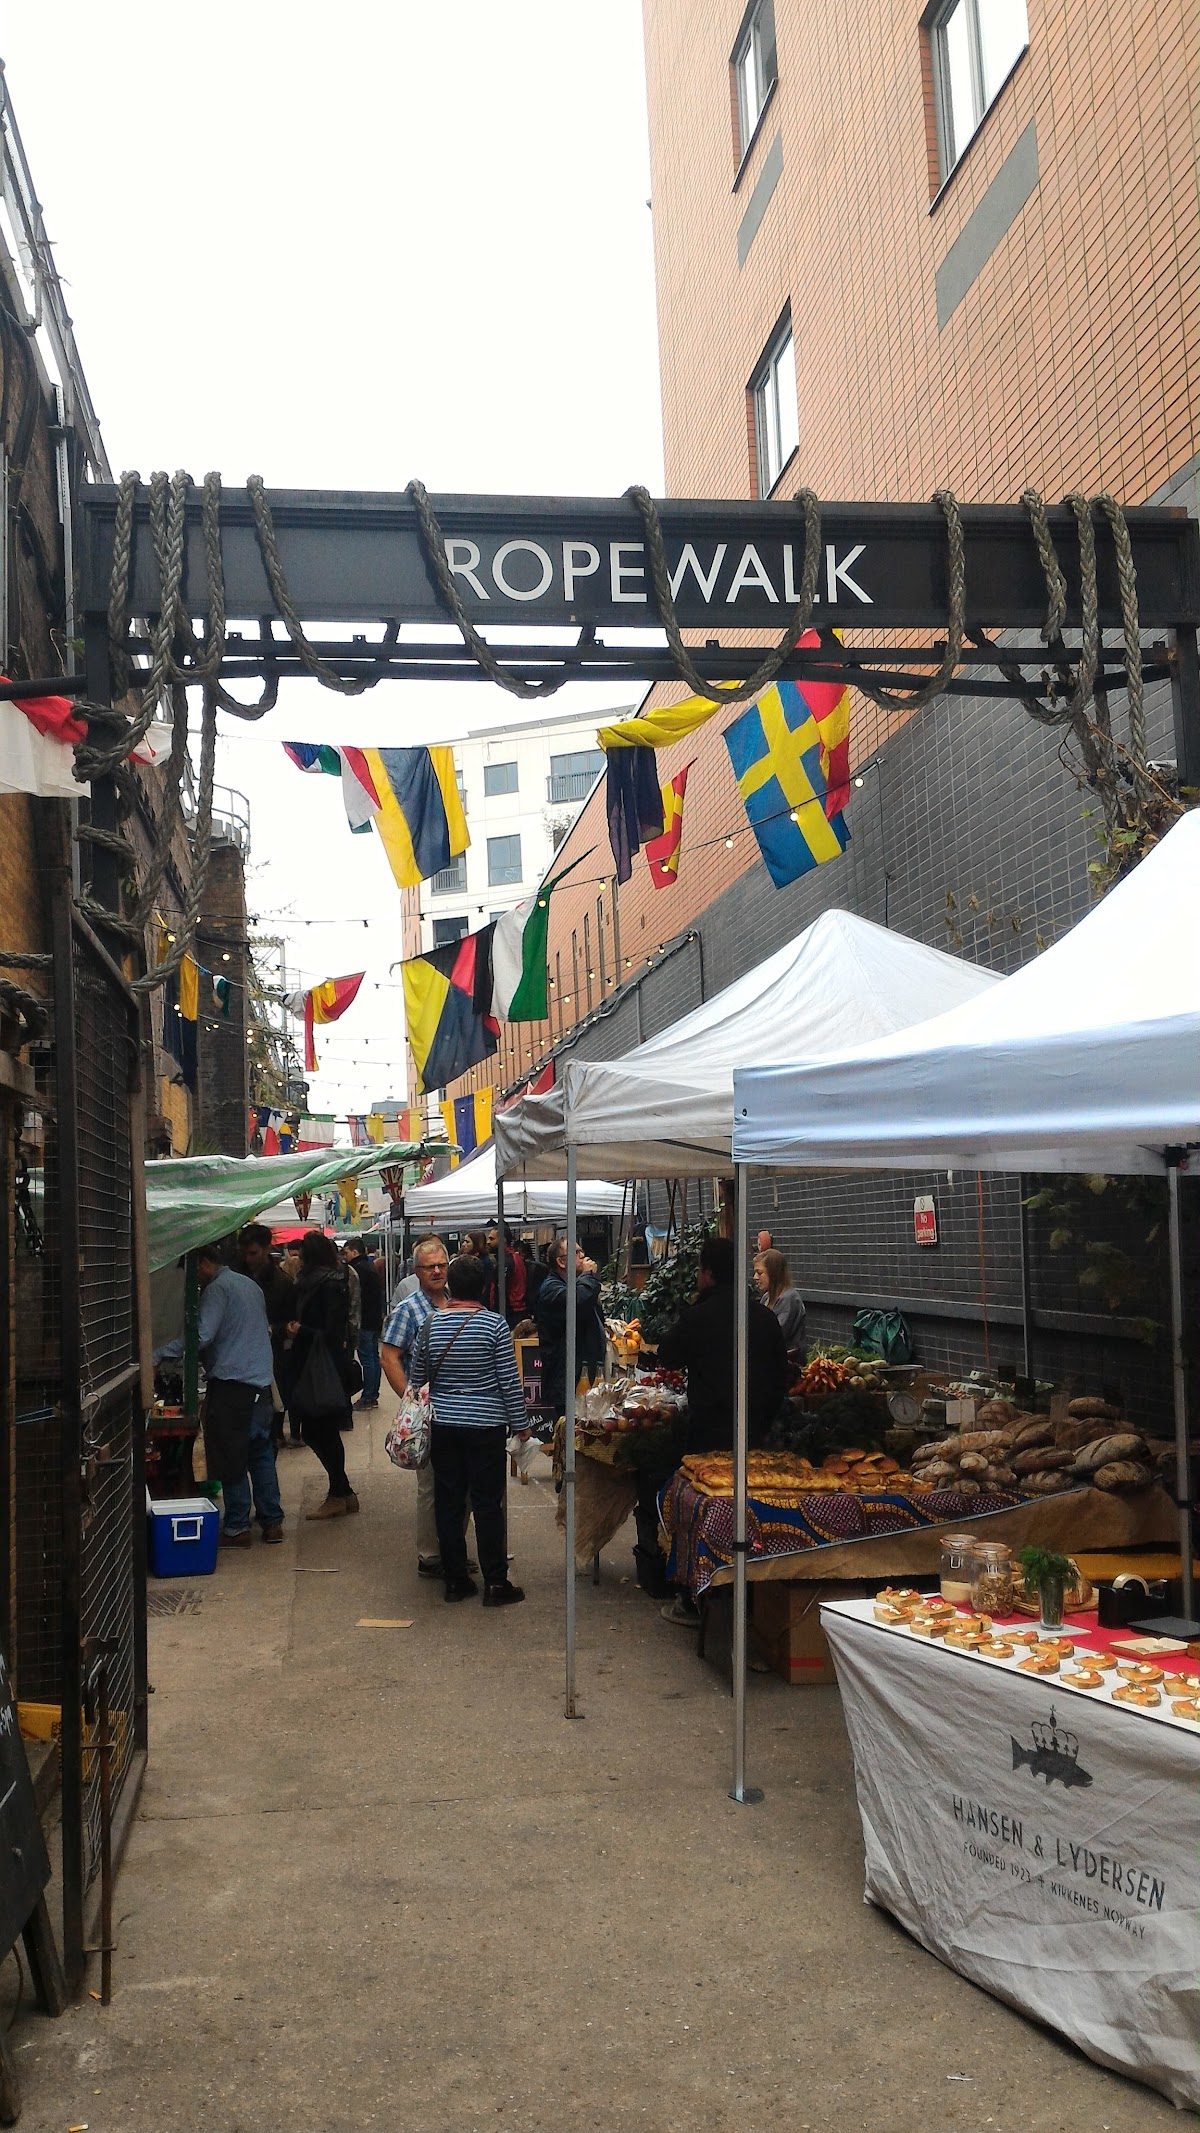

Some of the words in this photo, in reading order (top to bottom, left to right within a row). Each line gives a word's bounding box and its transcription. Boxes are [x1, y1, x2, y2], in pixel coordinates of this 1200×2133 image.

[952, 1793, 1023, 1850] HANSEN
[1034, 1834, 1045, 1861] &
[1056, 1837, 1166, 1912] LYDERSEN
[963, 1840, 1006, 1872] FOUNDED
[1010, 1862, 1031, 1883] 1923
[1051, 1881, 1100, 1914] KIRKENES
[1103, 1904, 1146, 1940] NORWAY
